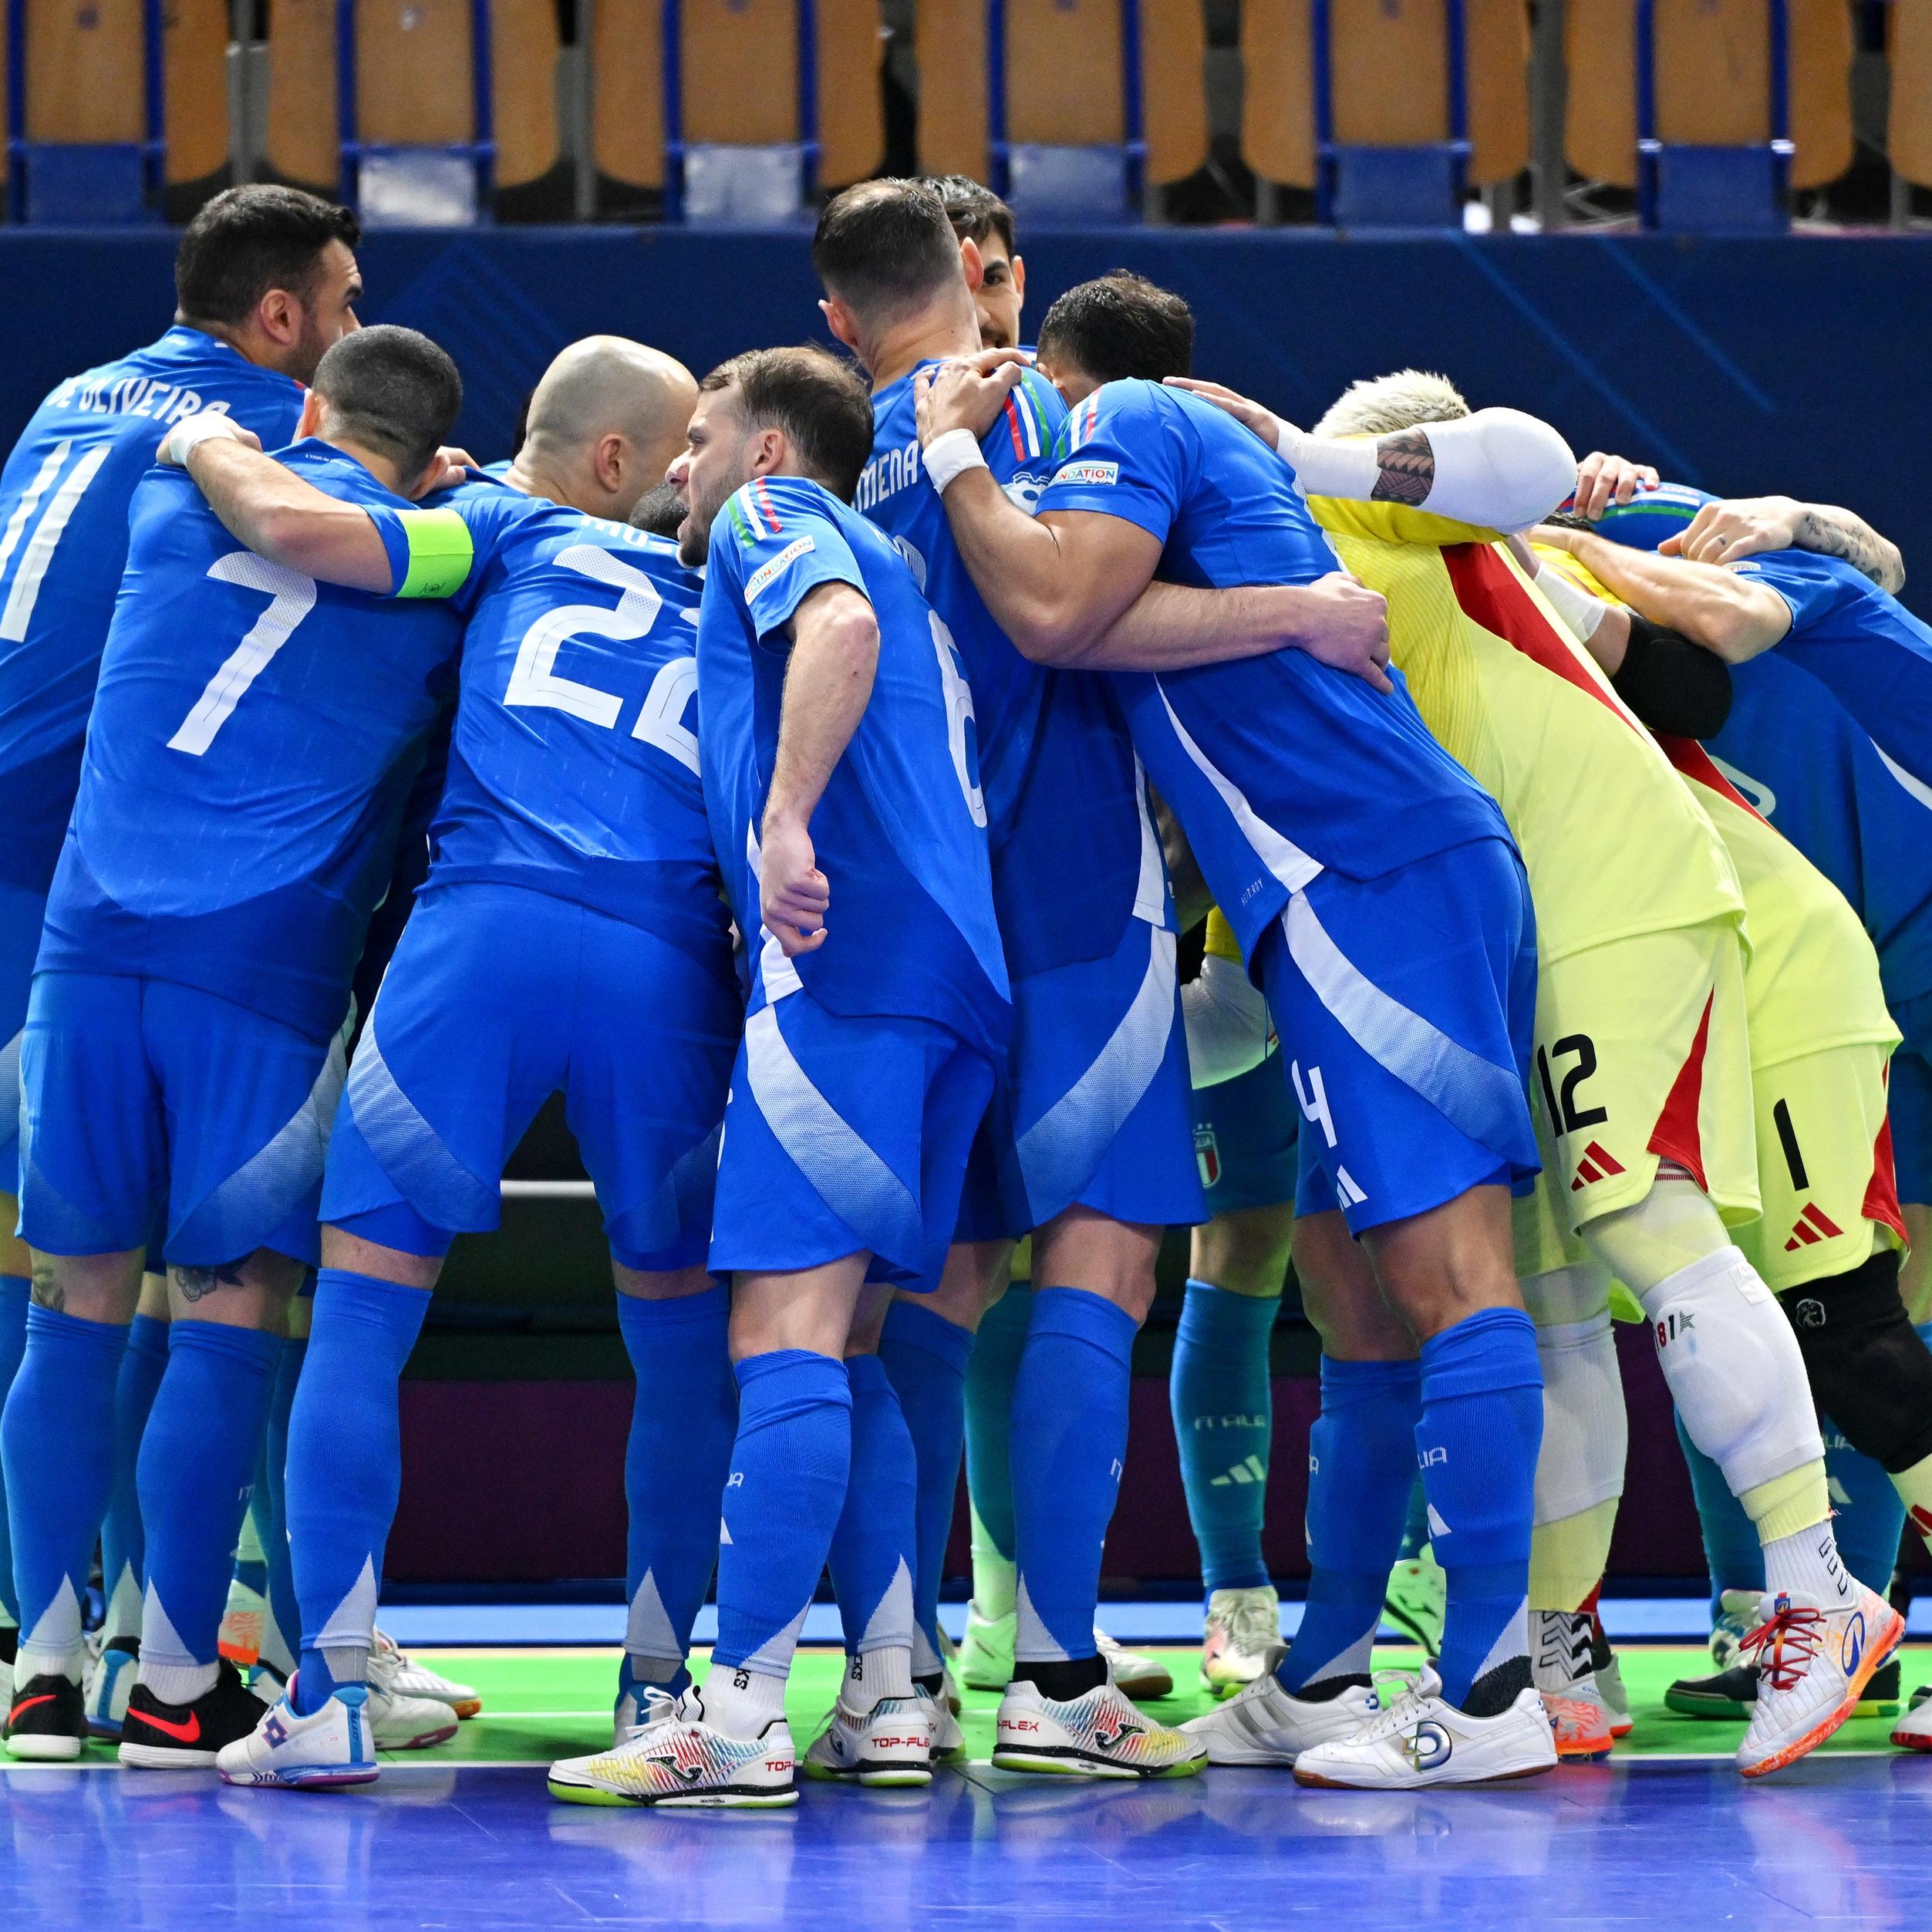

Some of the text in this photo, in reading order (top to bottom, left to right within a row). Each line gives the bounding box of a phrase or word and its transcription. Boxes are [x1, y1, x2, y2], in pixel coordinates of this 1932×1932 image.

[851, 439, 919, 513] MENA
[0, 440, 113, 644] 11
[166, 551, 318, 756] 7
[1291, 1059, 1338, 1149] 4
[1536, 1033, 1609, 1138] 12
[1772, 1097, 1811, 1192] 1
[1654, 1313, 1675, 1352] 81
